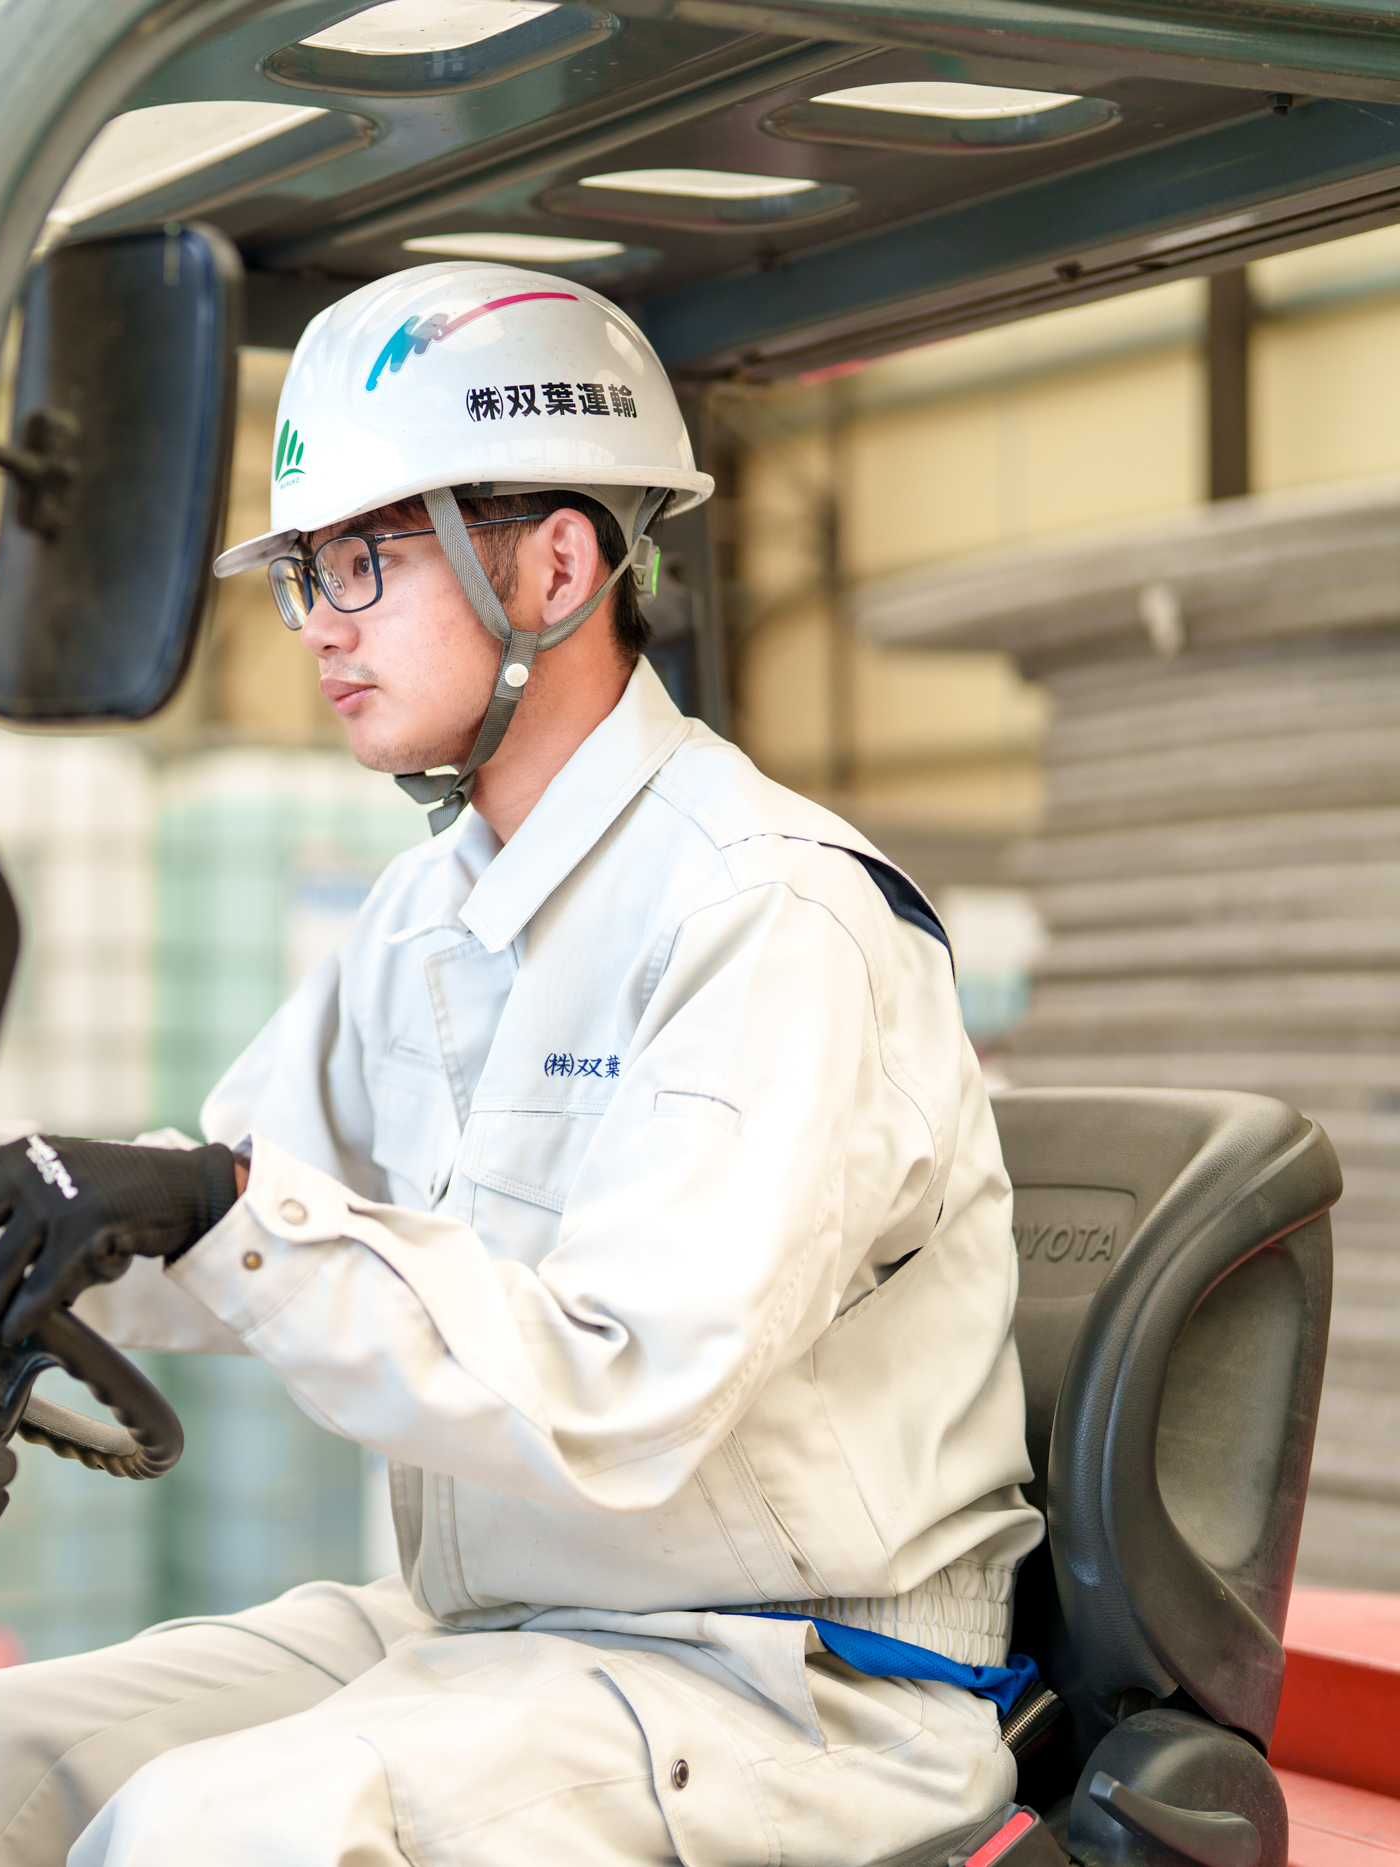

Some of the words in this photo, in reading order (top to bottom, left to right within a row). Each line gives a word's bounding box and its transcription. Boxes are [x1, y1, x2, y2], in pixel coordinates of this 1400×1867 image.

[466, 382, 638, 422] (株)双葉運輸
